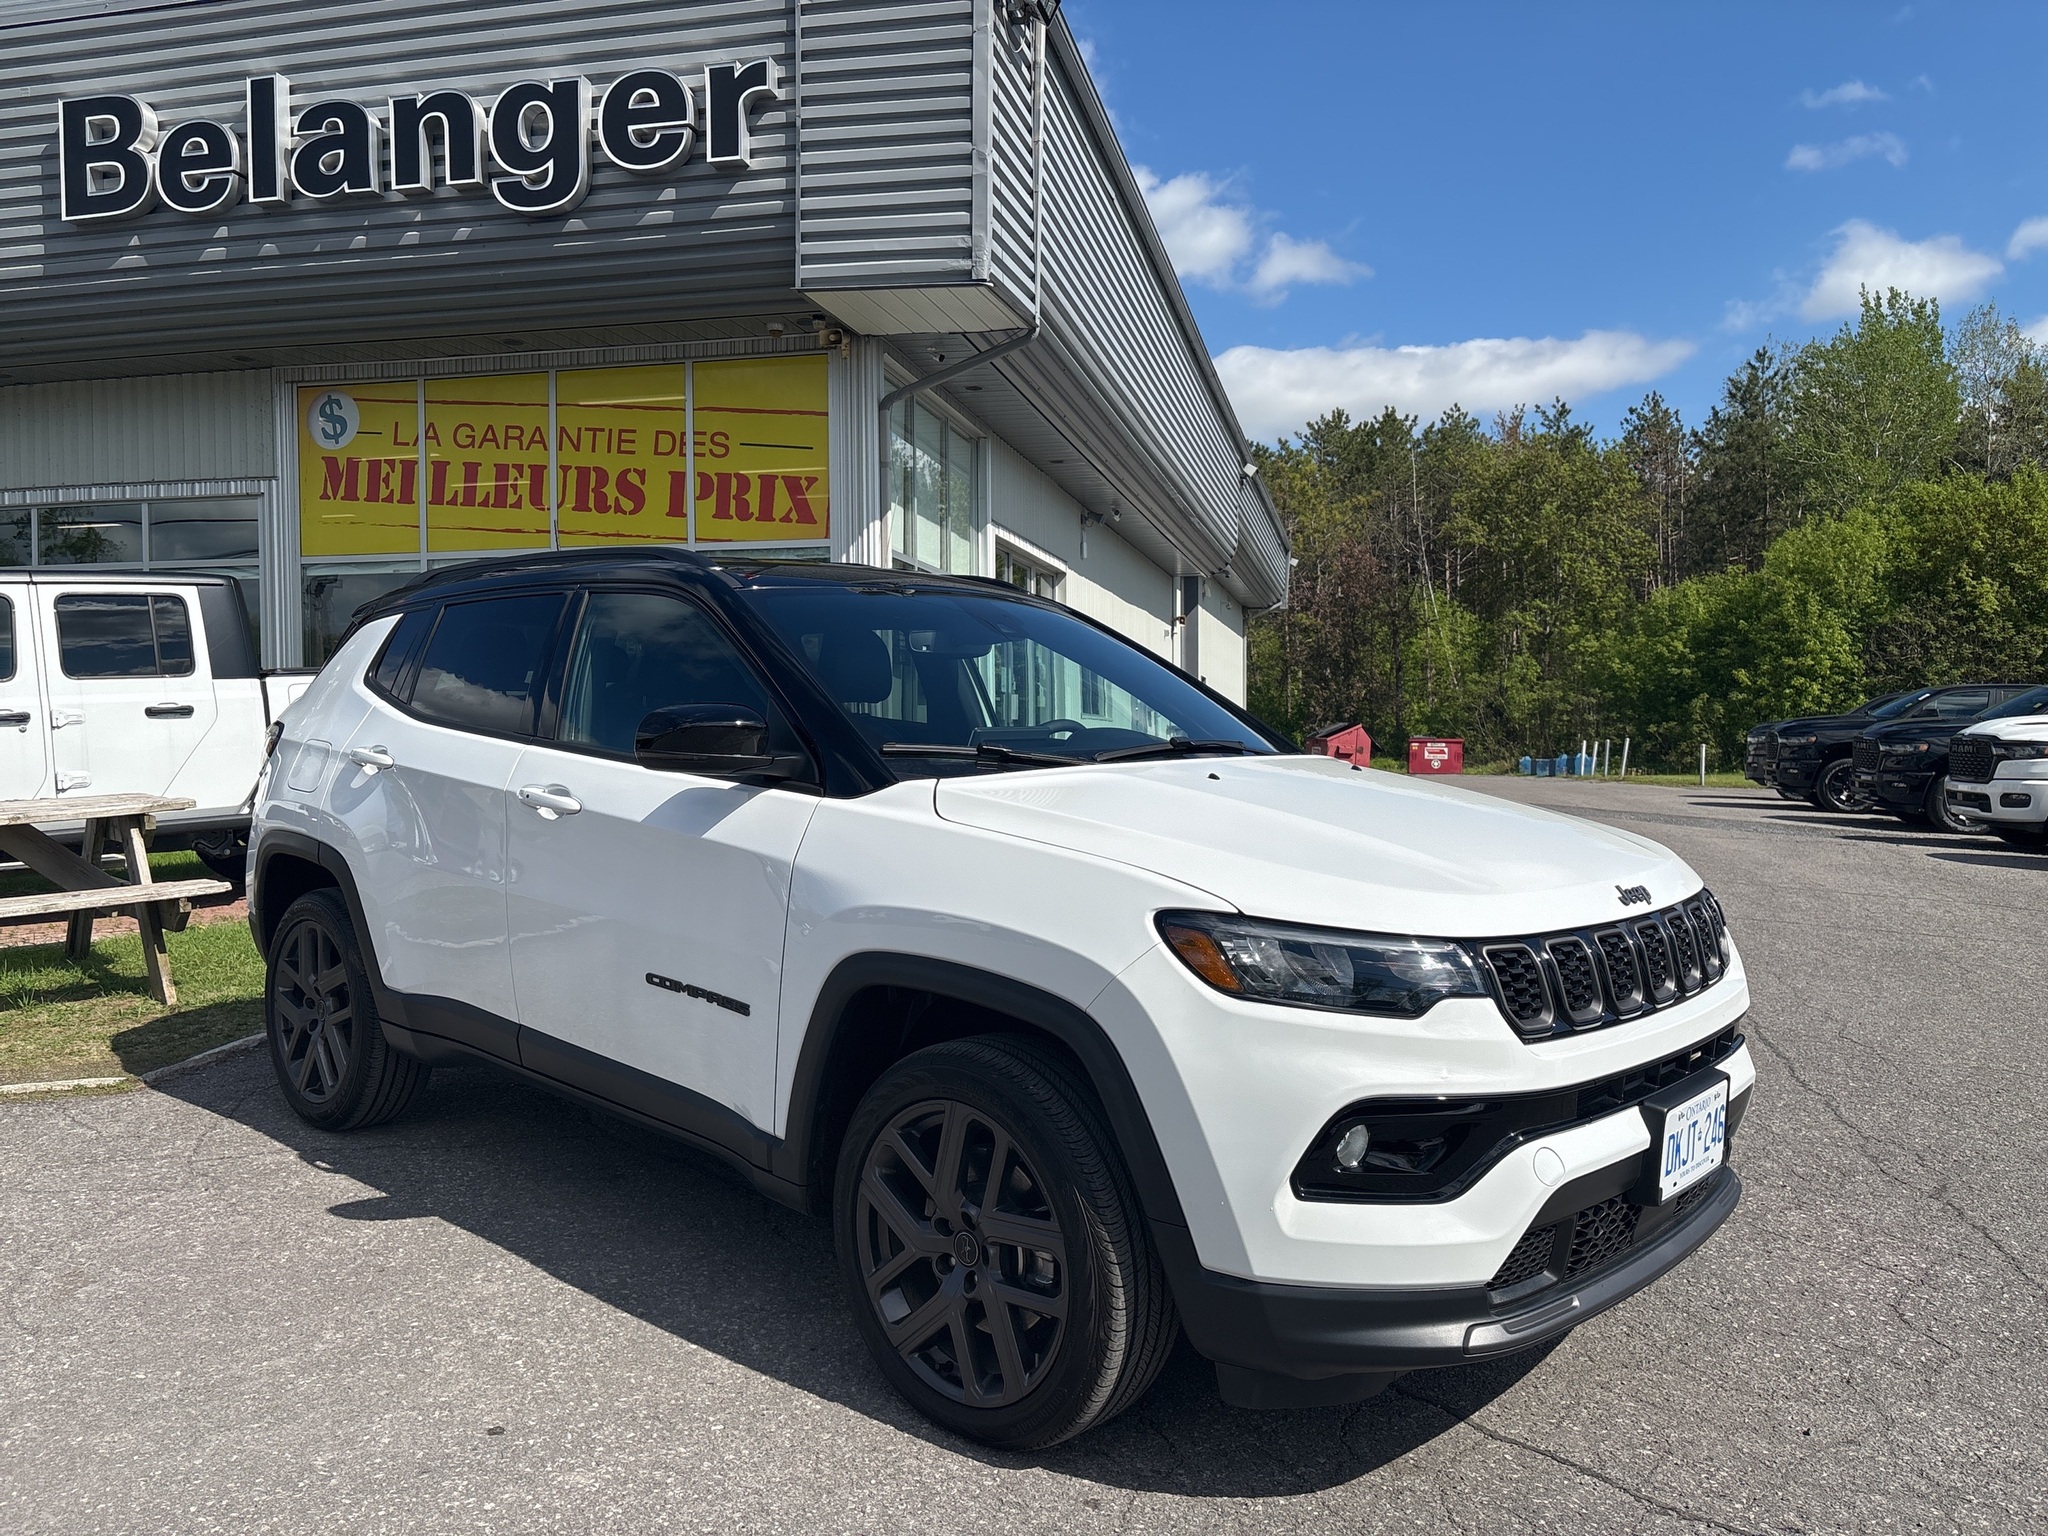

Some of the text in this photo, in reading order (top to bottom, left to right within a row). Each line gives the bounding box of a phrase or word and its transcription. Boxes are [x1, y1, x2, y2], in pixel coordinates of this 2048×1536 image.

[58, 56, 778, 221] Belanger
[393, 421, 730, 459] LA GARANTIE DES
[319, 456, 818, 525] MEILLEURS PRIX
[1951, 744, 1973, 753] RAM
[1614, 885, 1652, 906] Jeep
[645, 972, 751, 1017] COMPASS
[1685, 1097, 1712, 1121] ONTARIO
